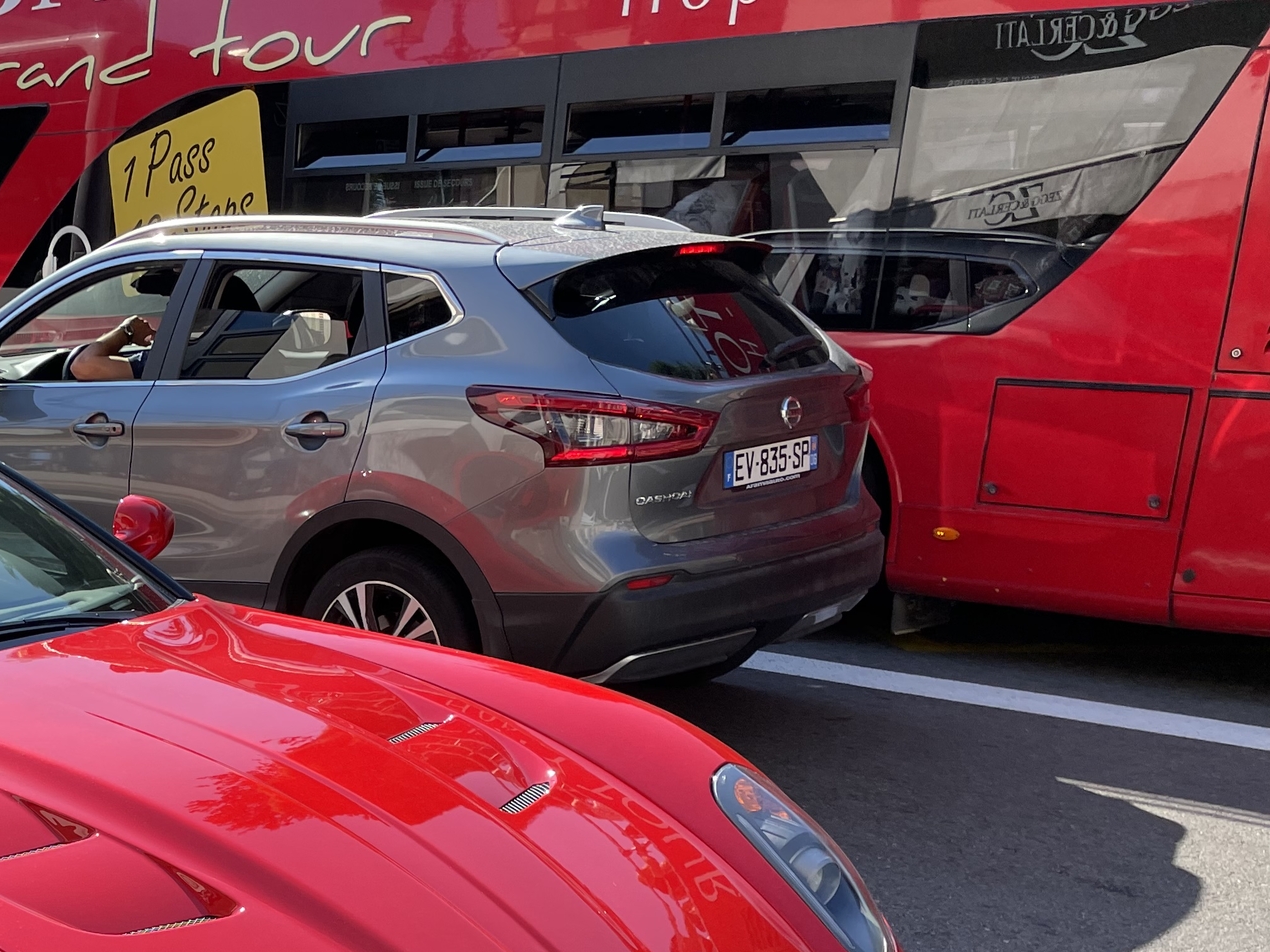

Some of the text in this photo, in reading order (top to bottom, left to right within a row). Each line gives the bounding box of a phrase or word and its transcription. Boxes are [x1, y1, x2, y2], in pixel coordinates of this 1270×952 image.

[189, 0, 412, 76] tour
[124, 129, 216, 203] 1 Pass
[735, 439, 810, 482] EV-835-SP
